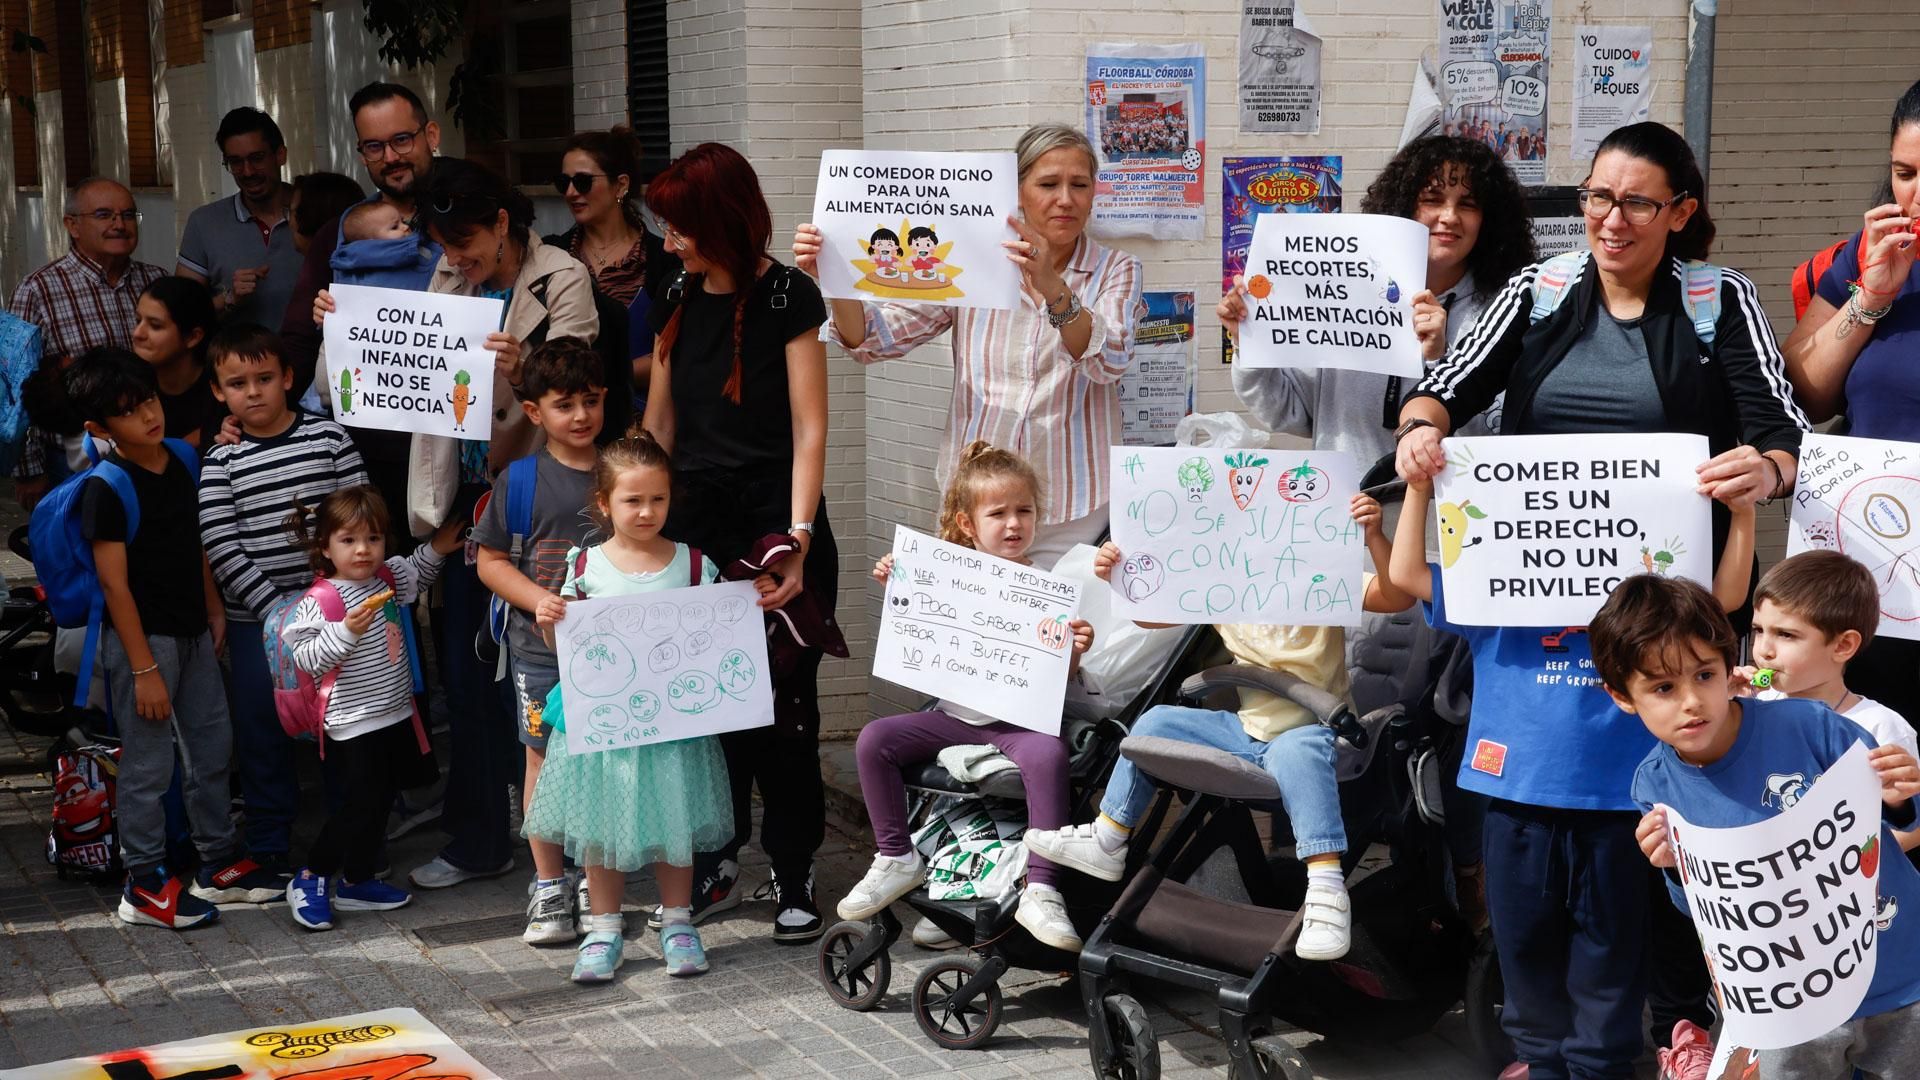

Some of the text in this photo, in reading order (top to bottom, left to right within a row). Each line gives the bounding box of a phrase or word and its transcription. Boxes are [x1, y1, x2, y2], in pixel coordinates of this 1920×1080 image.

[1442, 0, 1494, 16] VUELTA
[1520, 5, 1541, 16] Boli
[1460, 14, 1493, 30] COLE
[1581, 35, 1597, 47] YO
[1594, 48, 1631, 60] CUIDO
[1099, 64, 1194, 78] FLOORBALL CÓRDOBA
[1448, 68, 1468, 84] 5%
[1592, 65, 1614, 77] TUS
[1511, 80, 1539, 98] 10%
[1594, 82, 1639, 96] PEQUES
[1258, 112, 1300, 122] 626980733
[829, 166, 993, 182] UN COMEDOR DIGNO
[1099, 173, 1124, 181] GRUPO
[1126, 173, 1150, 181] TORRE
[867, 184, 950, 198] PARA UNA
[826, 200, 995, 217] ALIMENTACIÓN SANA
[1534, 224, 1566, 236] HATARRA
[1285, 236, 1359, 253] MENOS
[1266, 260, 1375, 282] RECORTES,
[1305, 280, 1348, 300] MÁS
[377, 307, 443, 327] CON LA
[1255, 305, 1404, 327] ALIMENTACIÓN
[348, 326, 468, 352] SALUD DE LA
[1272, 328, 1392, 350] DE CALIDAD
[362, 348, 448, 371] INFANCIA
[377, 372, 431, 392] NO SE
[363, 391, 444, 415] NEGOCIA
[1802, 446, 1827, 467] ME
[1474, 459, 1661, 482] COMER BIEN
[1525, 490, 1611, 511] ES UN
[1128, 490, 1178, 537] NO
[1244, 501, 1361, 546] JUEGA
[1494, 518, 1646, 541] DERECHO,
[933, 548, 982, 570] COMIDA
[992, 564, 1007, 579] DE
[1166, 537, 1242, 573] CON
[1523, 548, 1618, 569] NO UN
[913, 592, 957, 618] POCO
[951, 578, 1050, 613] MUCHO NOMBRE
[950, 635, 960, 650] A
[902, 646, 1028, 689] NO A COMIDA DE CASA
[1546, 660, 1570, 671] KEEP
[1537, 674, 1561, 684] KEEP
[59, 841, 110, 868] SPEED
[219, 868, 241, 882] NIKE
[1695, 844, 1862, 932] NIÑOS NO
[1717, 892, 1862, 973] SON UN
[1721, 918, 1875, 1015] NEGOCIO
